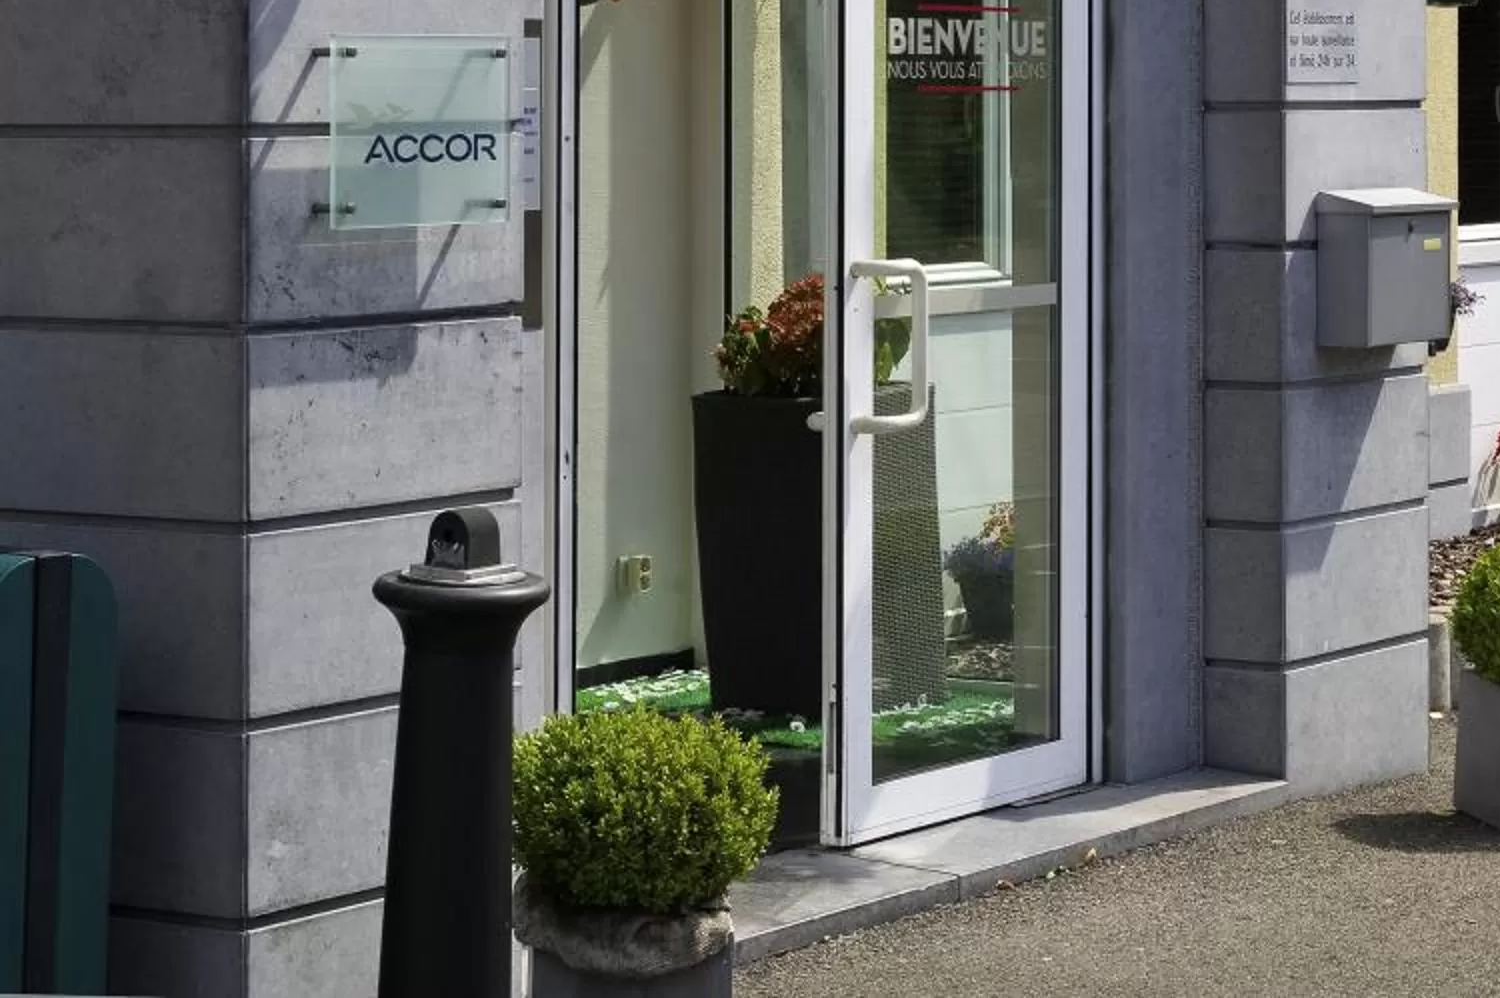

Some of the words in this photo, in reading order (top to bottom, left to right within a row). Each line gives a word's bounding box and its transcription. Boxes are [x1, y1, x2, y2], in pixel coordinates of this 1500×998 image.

[887, 60, 926, 79] NOUS
[929, 60, 965, 79] VOUS
[364, 133, 497, 164] ACCOR
